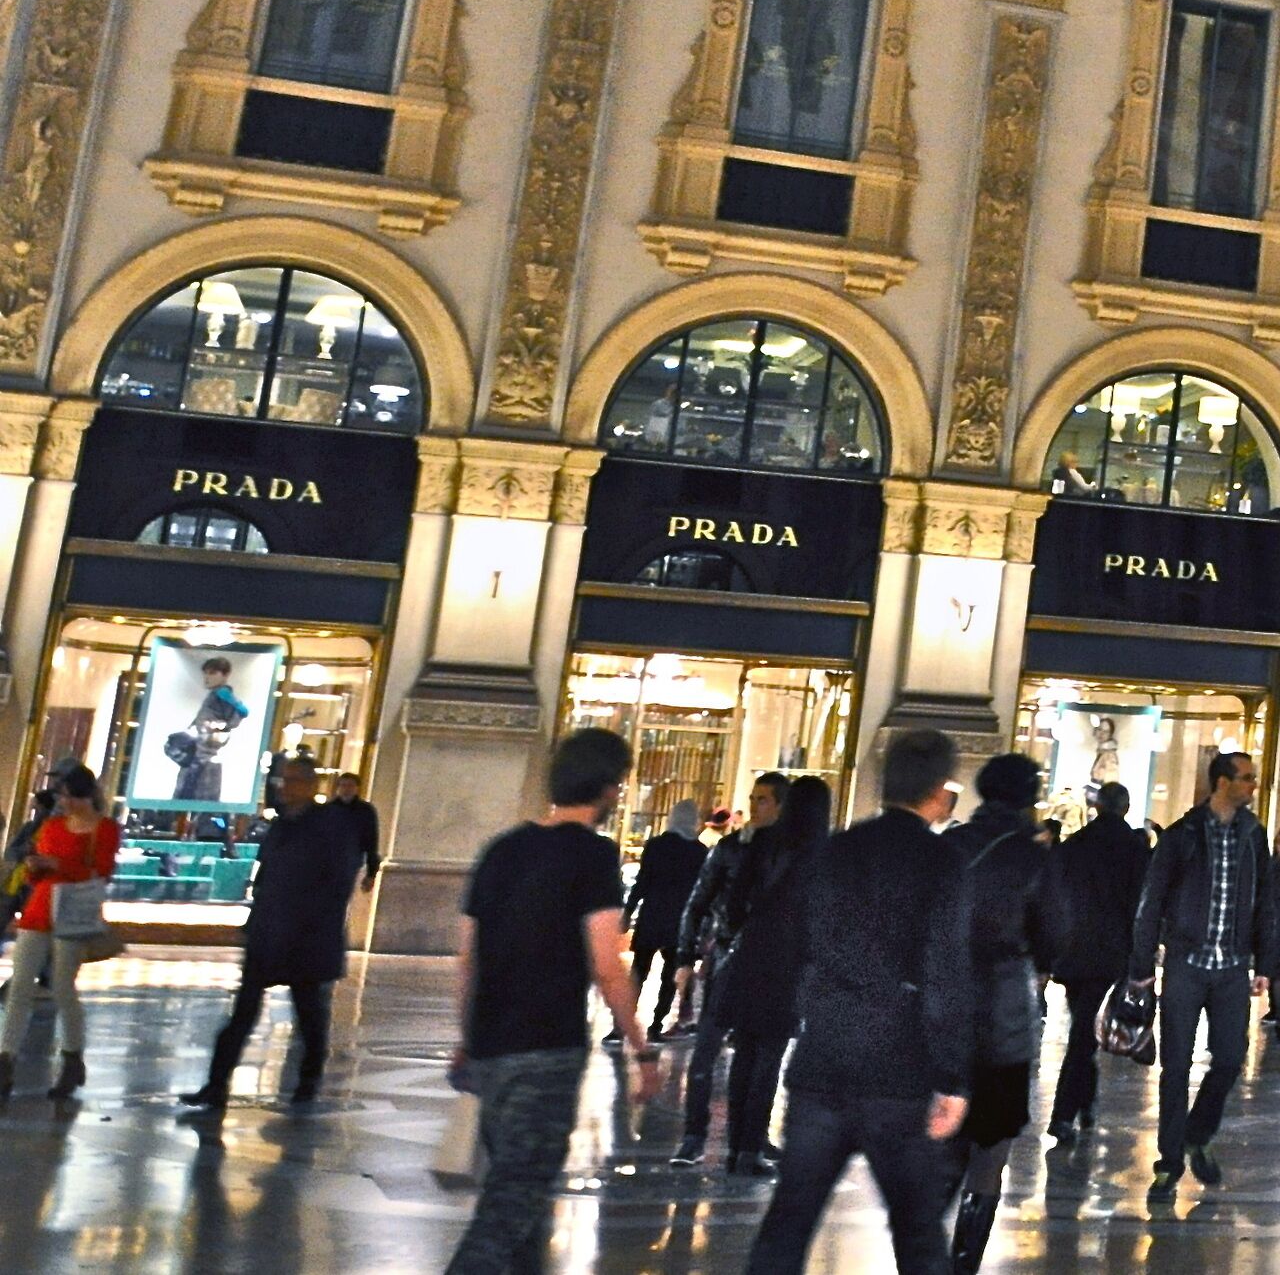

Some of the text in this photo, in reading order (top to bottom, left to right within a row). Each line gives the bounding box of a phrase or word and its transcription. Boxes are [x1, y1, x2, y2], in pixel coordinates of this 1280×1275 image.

[172, 468, 323, 505] PRADA
[666, 515, 800, 548] PRADA
[1103, 553, 1221, 583] PRADA
